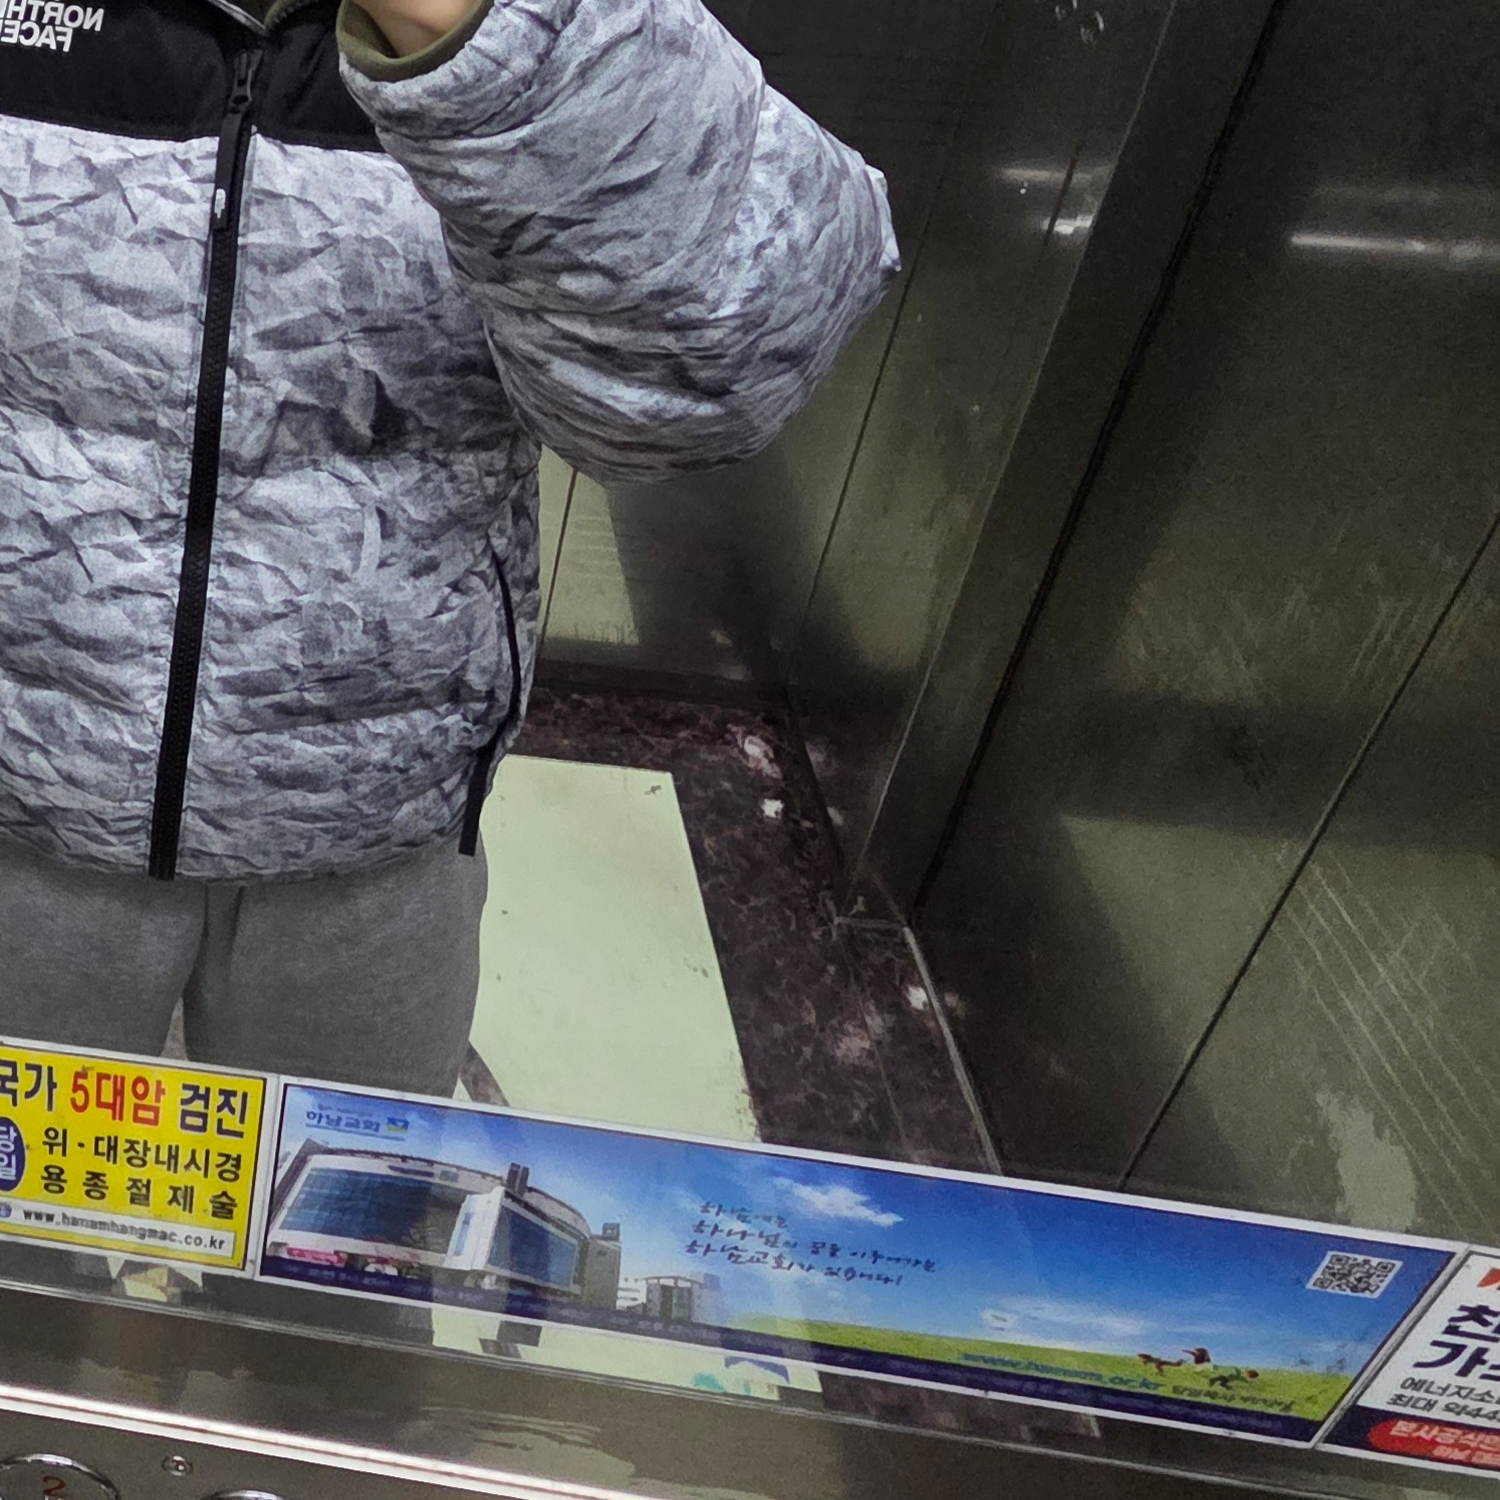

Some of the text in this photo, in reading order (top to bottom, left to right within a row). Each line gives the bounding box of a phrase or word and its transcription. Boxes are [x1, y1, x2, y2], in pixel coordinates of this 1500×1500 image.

[69, 1070, 167, 1128] 5대암
[179, 1082, 249, 1139] 검진
[1386, 1393, 1439, 1412] 최대
[42, 1475, 68, 1497] 2
